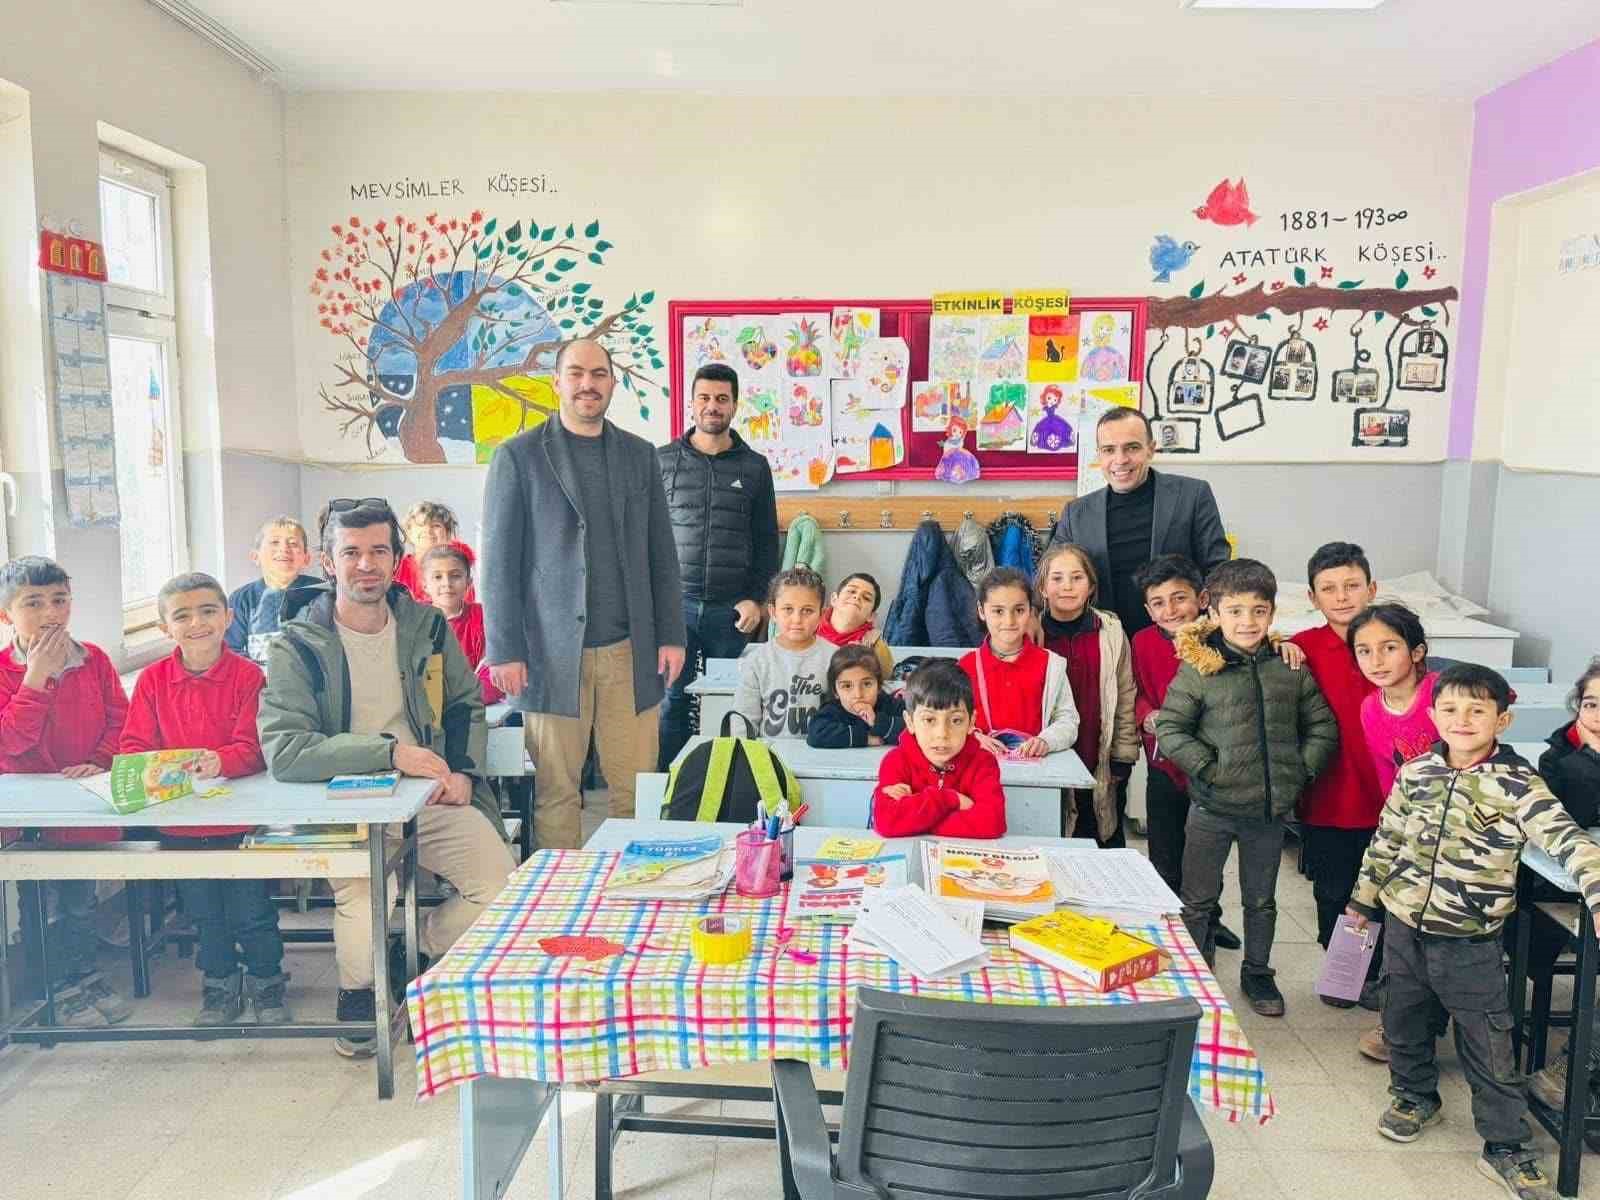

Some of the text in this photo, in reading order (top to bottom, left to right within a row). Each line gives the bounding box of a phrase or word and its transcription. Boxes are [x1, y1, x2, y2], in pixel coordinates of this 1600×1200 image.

[350, 177, 465, 200] MEVSİMLER
[1219, 247, 1329, 268] ATATÜRK
[934, 296, 1069, 311] ETKİNLİK KÖŞESİ
[790, 673, 823, 696] The
